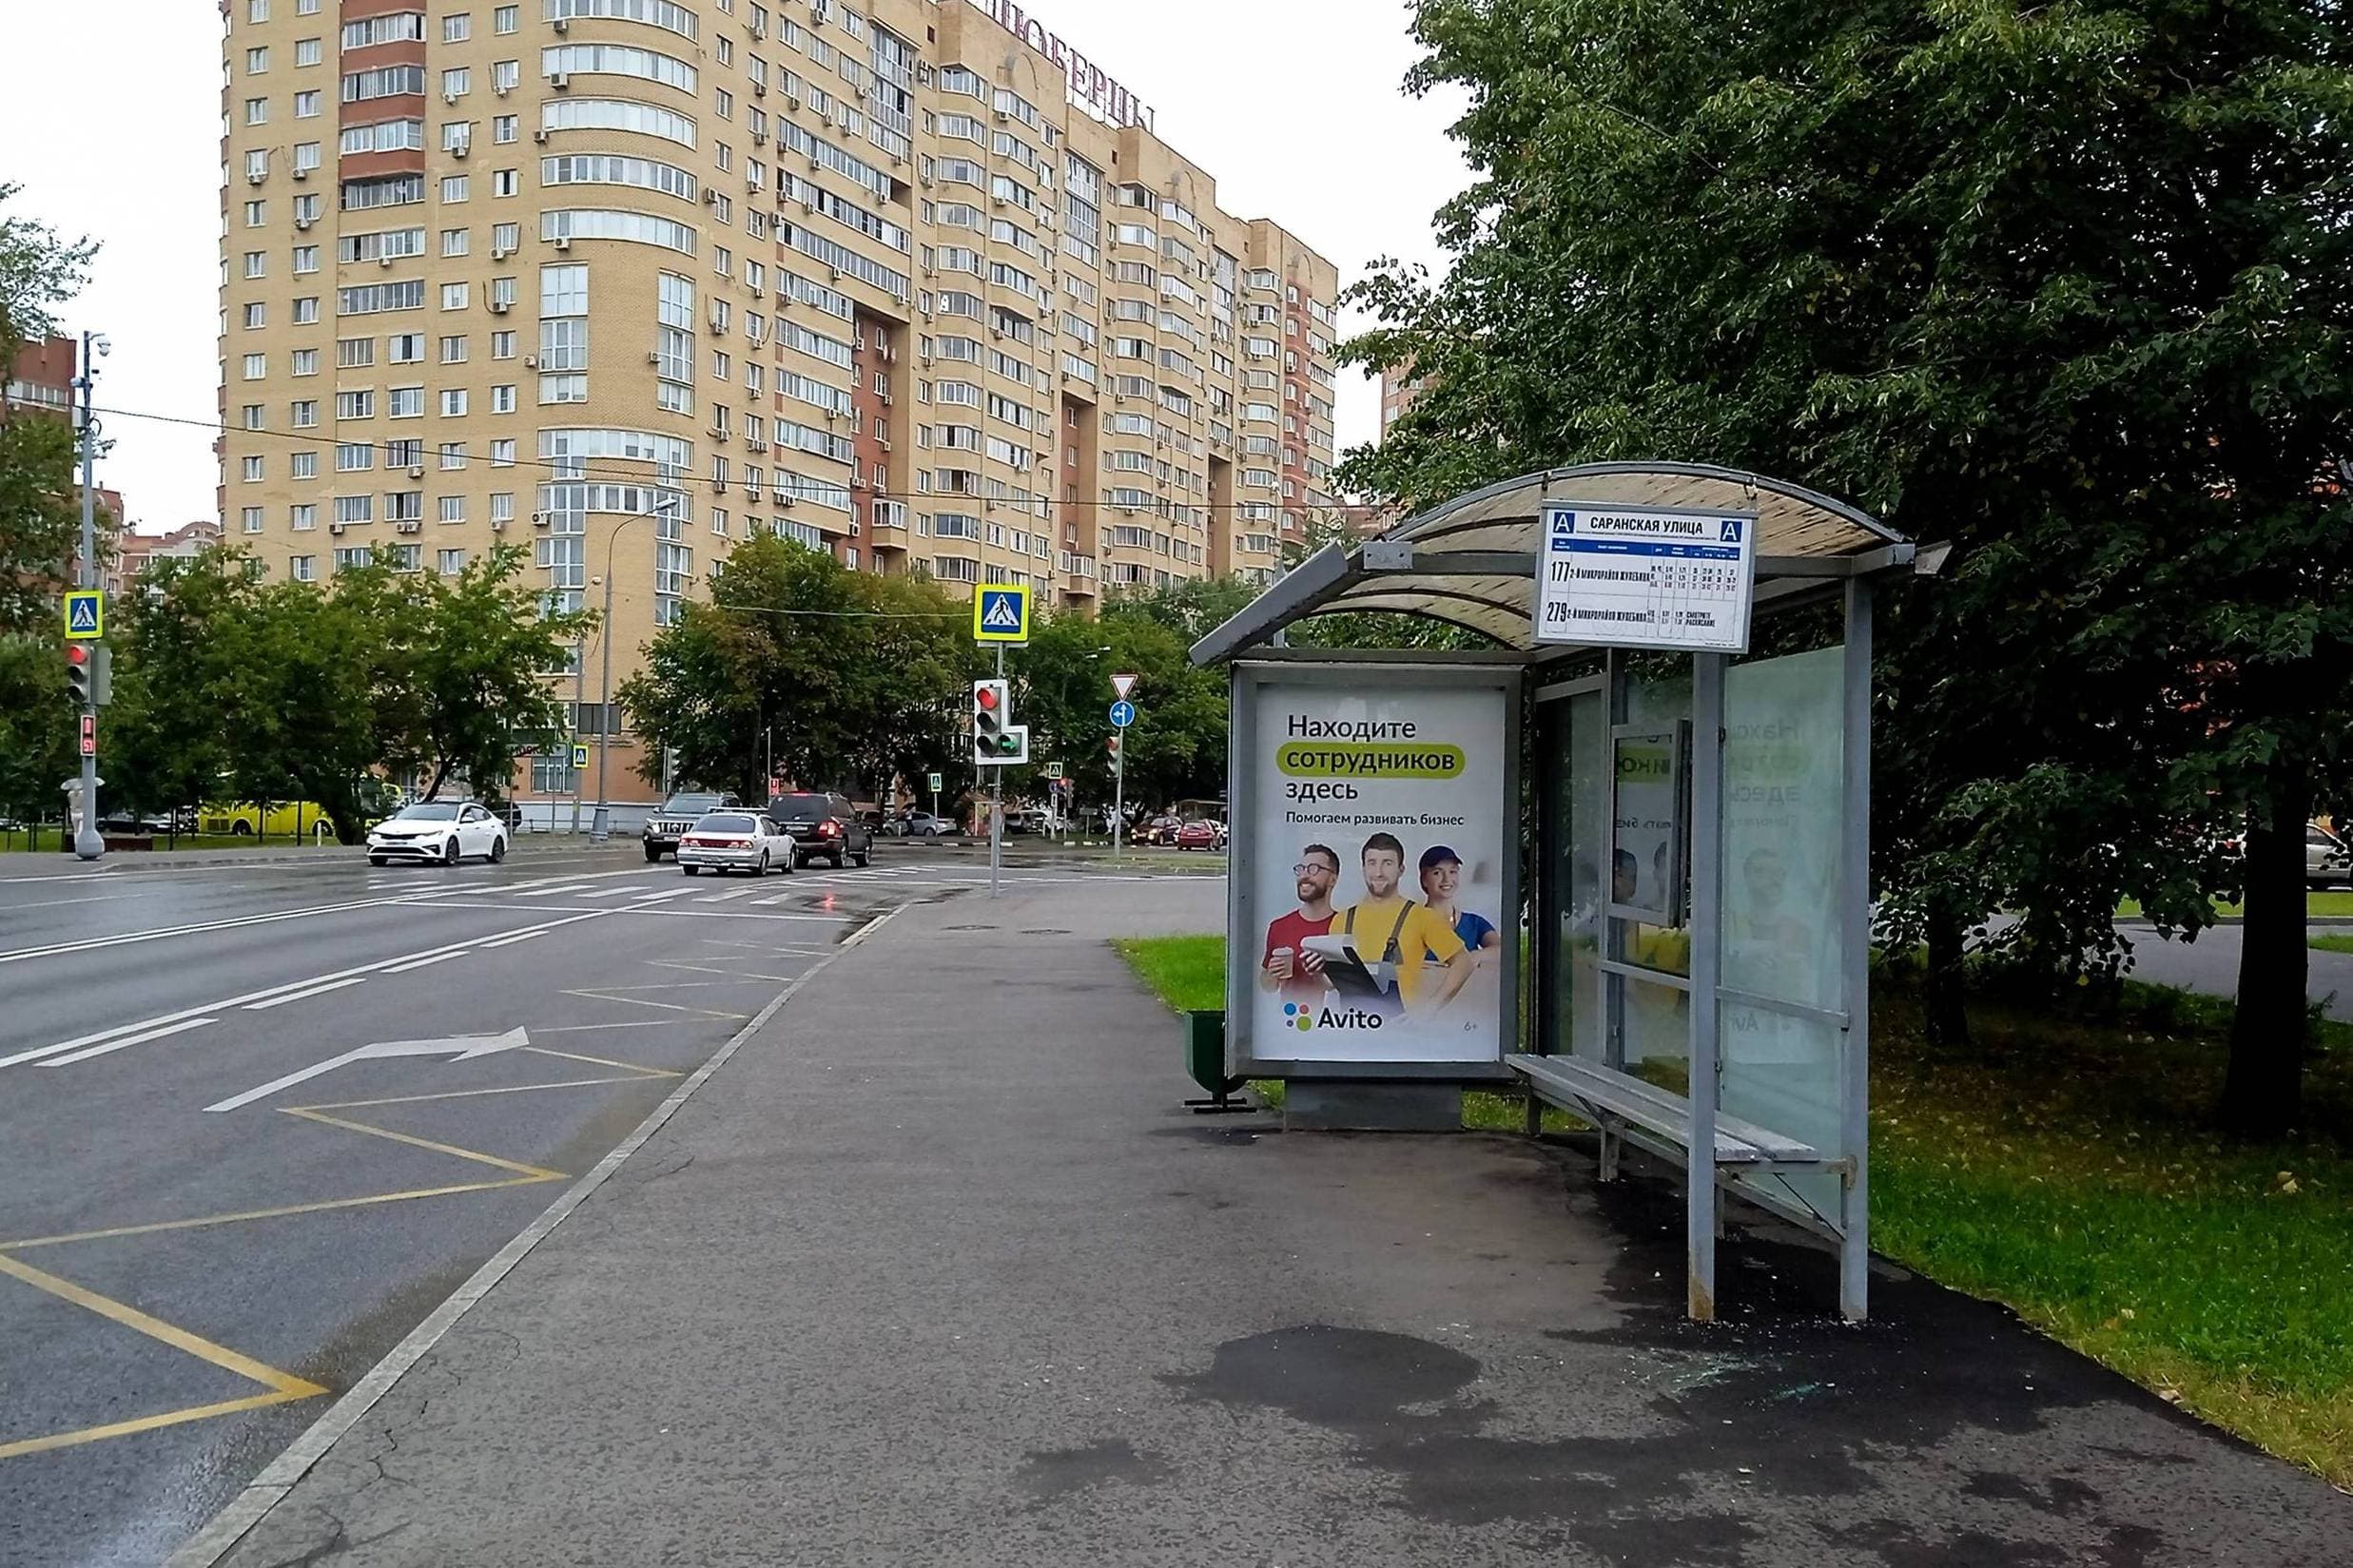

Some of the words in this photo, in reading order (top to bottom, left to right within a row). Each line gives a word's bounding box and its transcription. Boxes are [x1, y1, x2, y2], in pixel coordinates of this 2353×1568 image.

[1590, 516, 1661, 532] САРАНСКАЯ
[1663, 520, 1703, 535] УЛИЦА
[1551, 561, 1570, 582] 177
[1546, 602, 1567, 622] 279
[1288, 714, 1416, 743] Находите
[1286, 749, 1455, 774] сотрудников
[1285, 780, 1359, 803] здесь
[1286, 811, 1351, 825] Помогаем
[1354, 814, 1417, 827] развивать
[1420, 813, 1465, 826] бизнес
[1317, 1007, 1383, 1030] Avito
[1464, 1021, 1479, 1032] 6+
